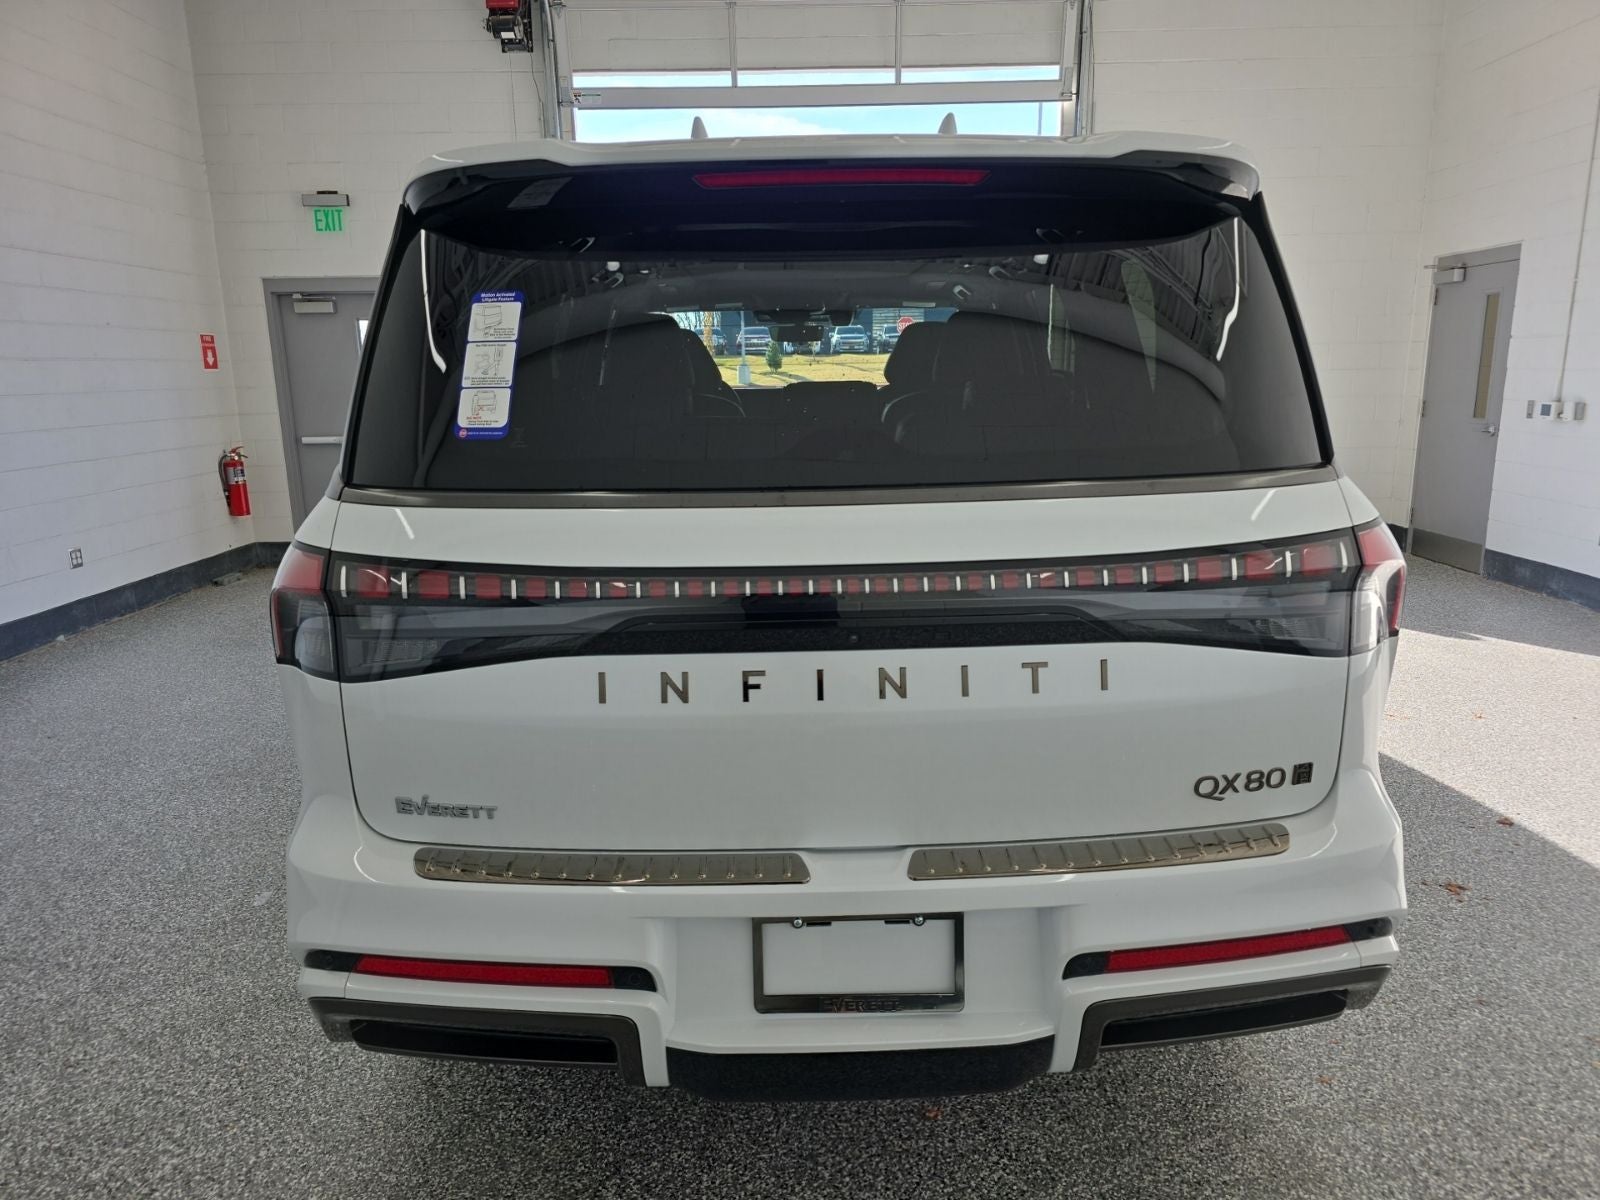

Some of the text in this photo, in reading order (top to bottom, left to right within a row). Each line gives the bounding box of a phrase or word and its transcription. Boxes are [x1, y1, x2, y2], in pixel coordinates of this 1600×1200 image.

[314, 208, 343, 232] EXIT
[598, 658, 1110, 705] INFINITI
[1193, 766, 1287, 802] QX80
[394, 794, 499, 820] EVERETT
